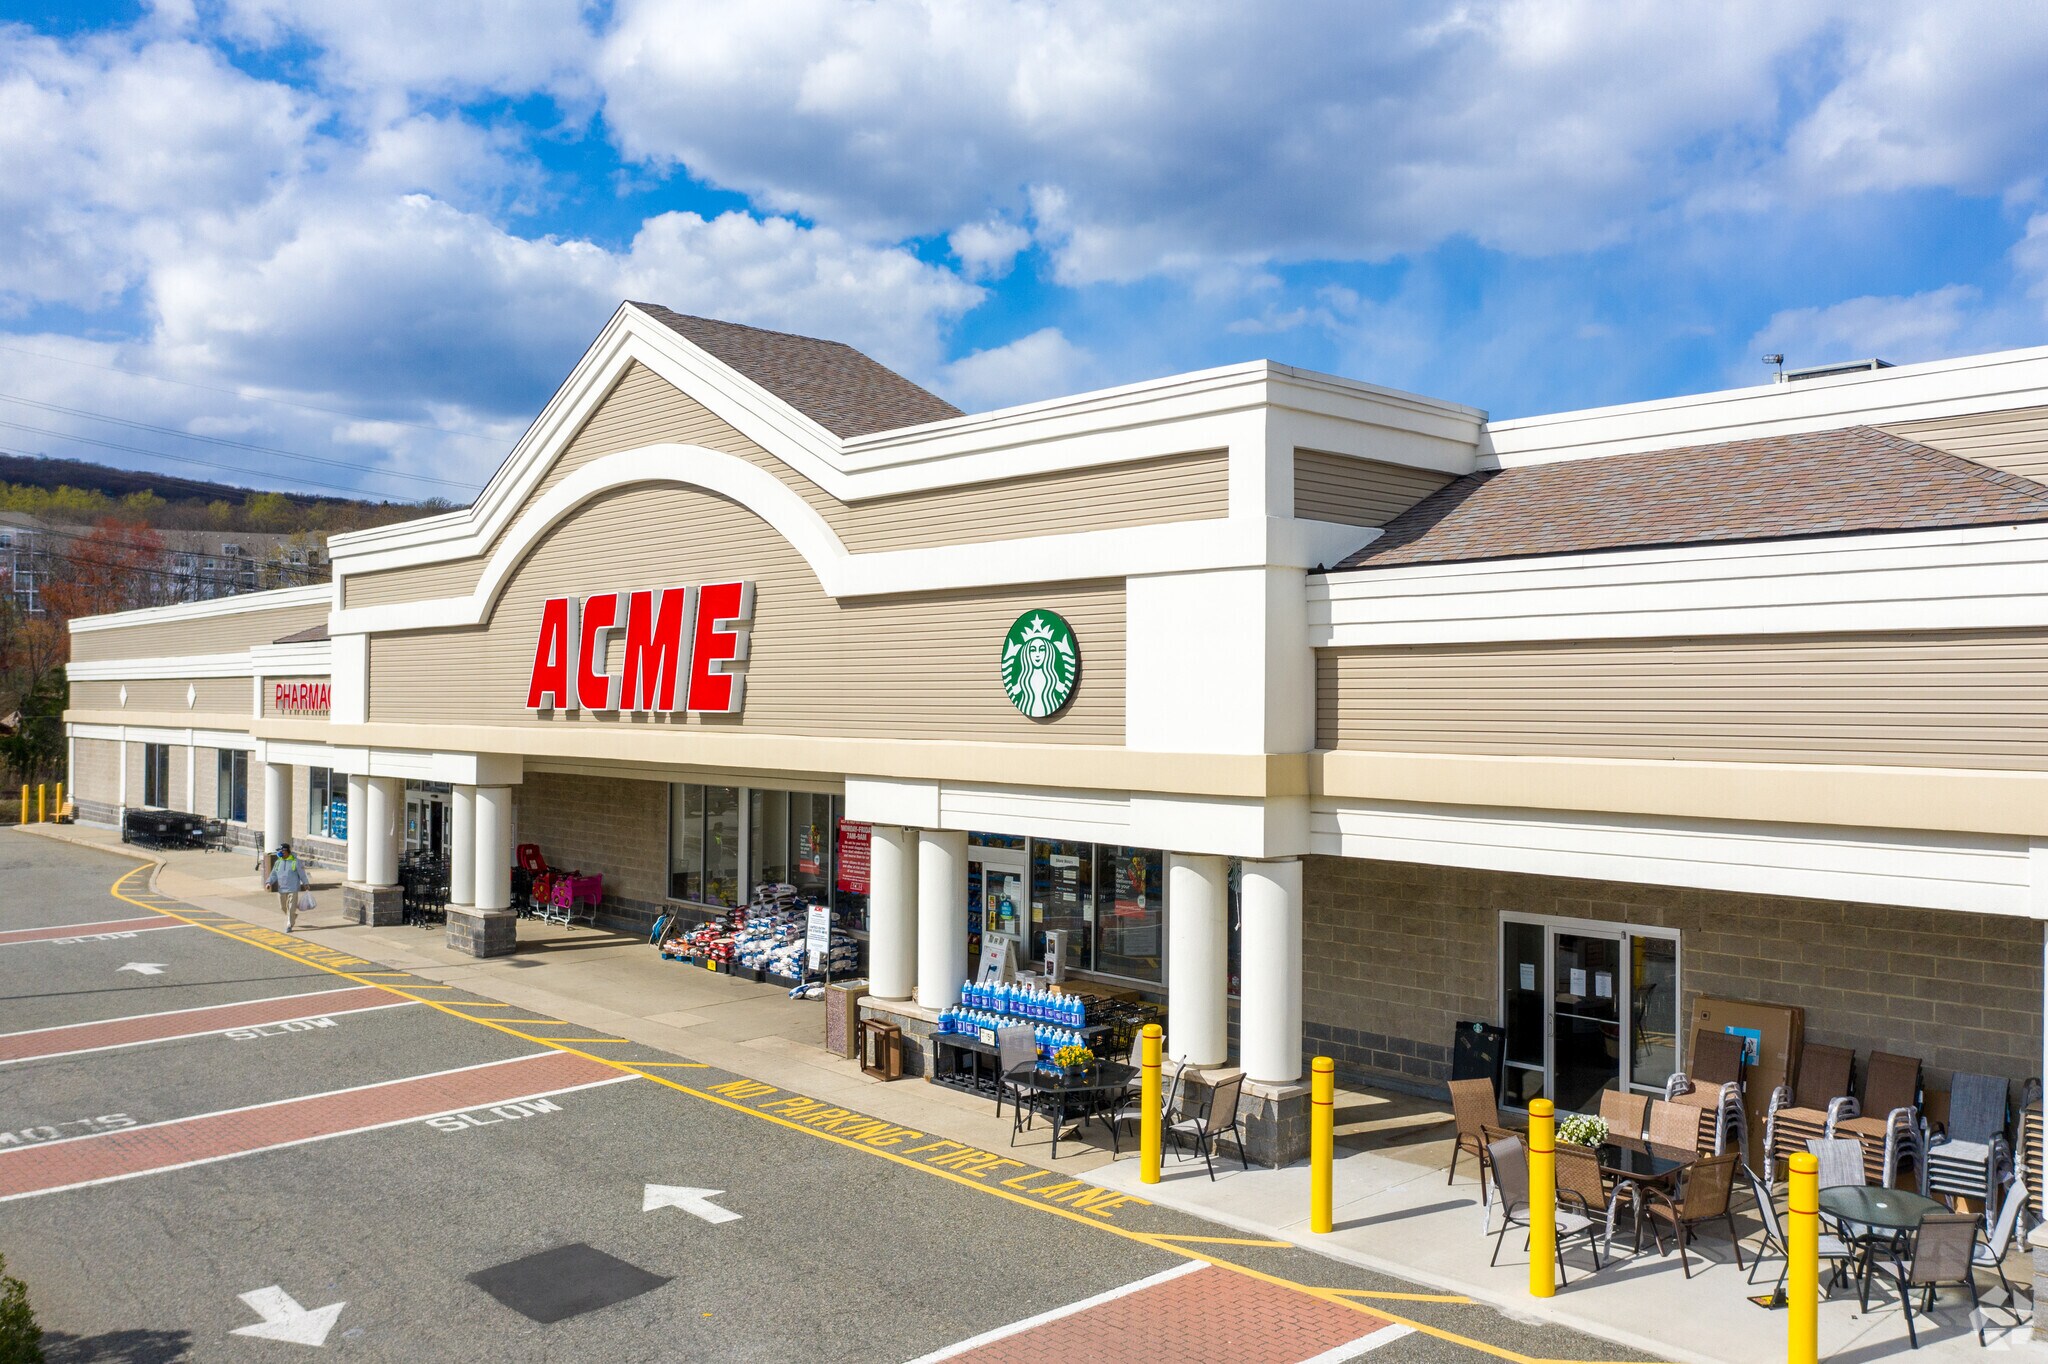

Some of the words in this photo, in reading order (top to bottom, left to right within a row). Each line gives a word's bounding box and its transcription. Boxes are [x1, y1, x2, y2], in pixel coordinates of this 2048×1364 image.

[526, 581, 755, 713] ACME
[224, 1017, 339, 1041] SLOW
[425, 1099, 564, 1132] SLOW
[706, 1079, 778, 1099] NO
[757, 1096, 924, 1147] PARKING
[901, 1139, 1026, 1178] FIRE
[1000, 1170, 1154, 1218] LANE
